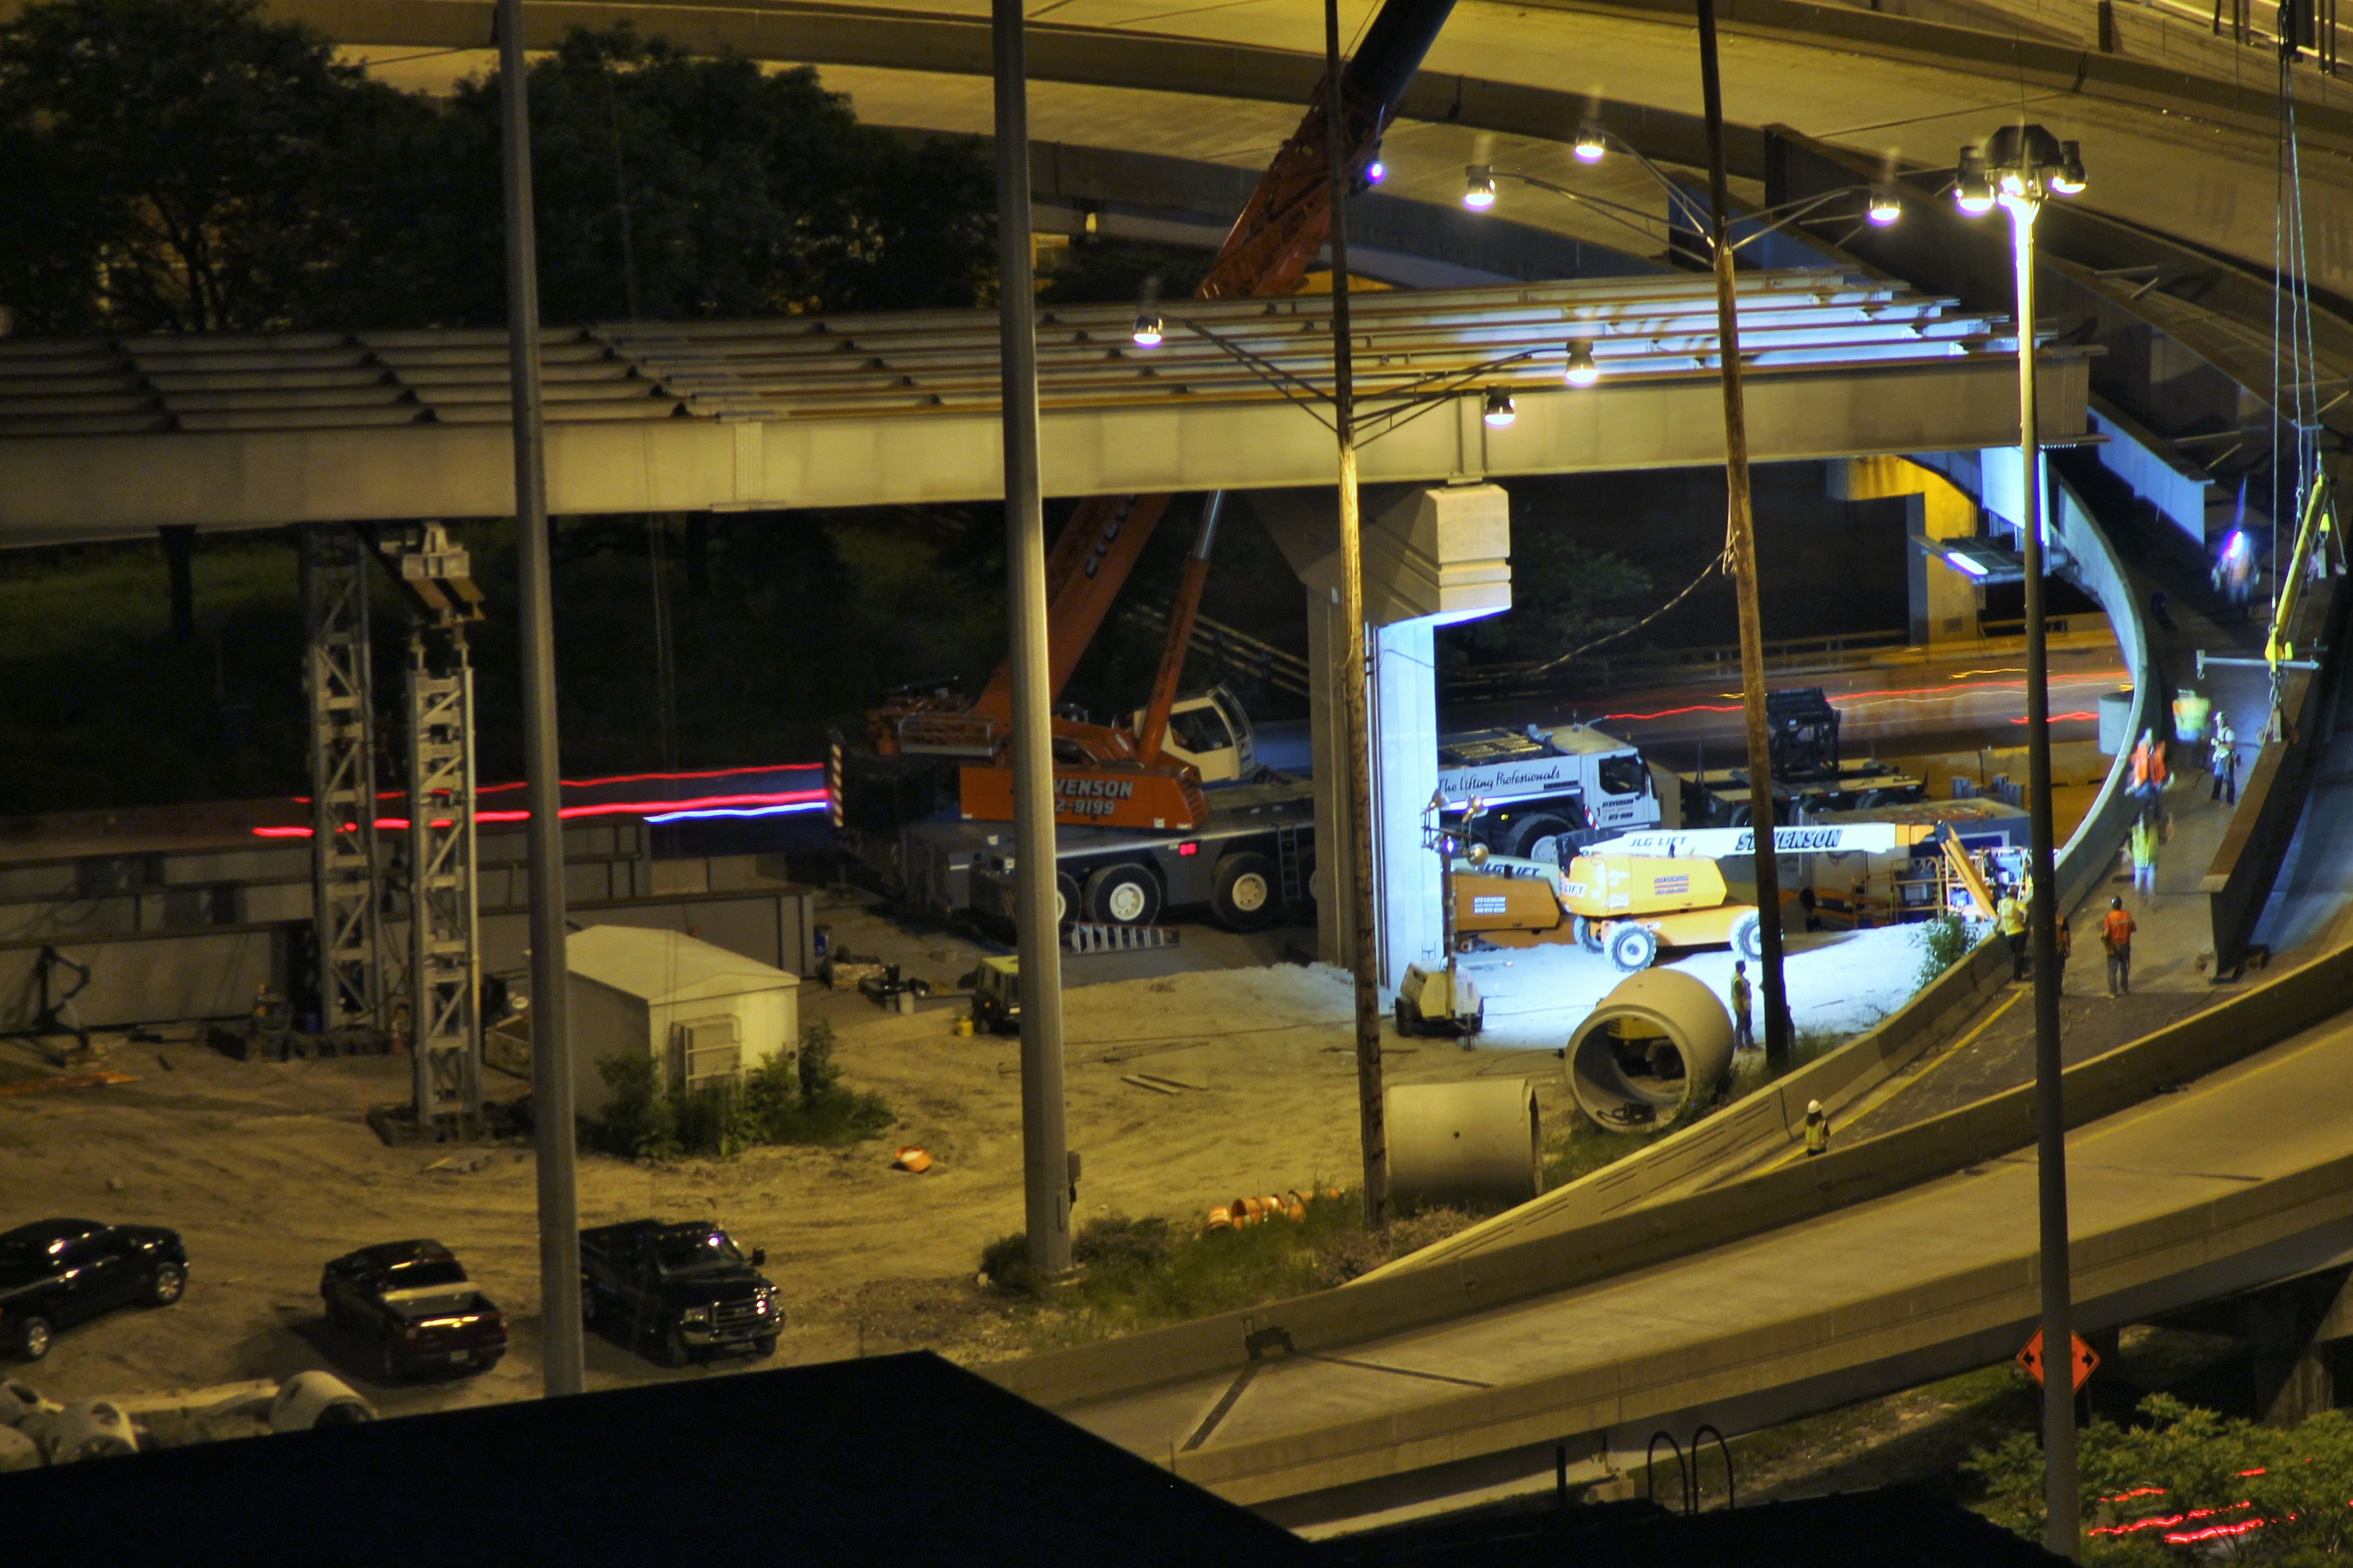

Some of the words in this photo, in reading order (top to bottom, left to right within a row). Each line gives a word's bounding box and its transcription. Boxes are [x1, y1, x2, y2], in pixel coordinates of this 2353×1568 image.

[1054, 778, 1134, 798] VENSON
[1438, 778, 1457, 793] The
[1460, 773, 1493, 790] Lifting
[1496, 765, 1561, 786] Professionals
[1055, 798, 1116, 816] 2-9199
[1628, 837, 1654, 847] JLG
[1657, 836, 1688, 846] LIFT
[1735, 828, 1843, 851] STVENSON
